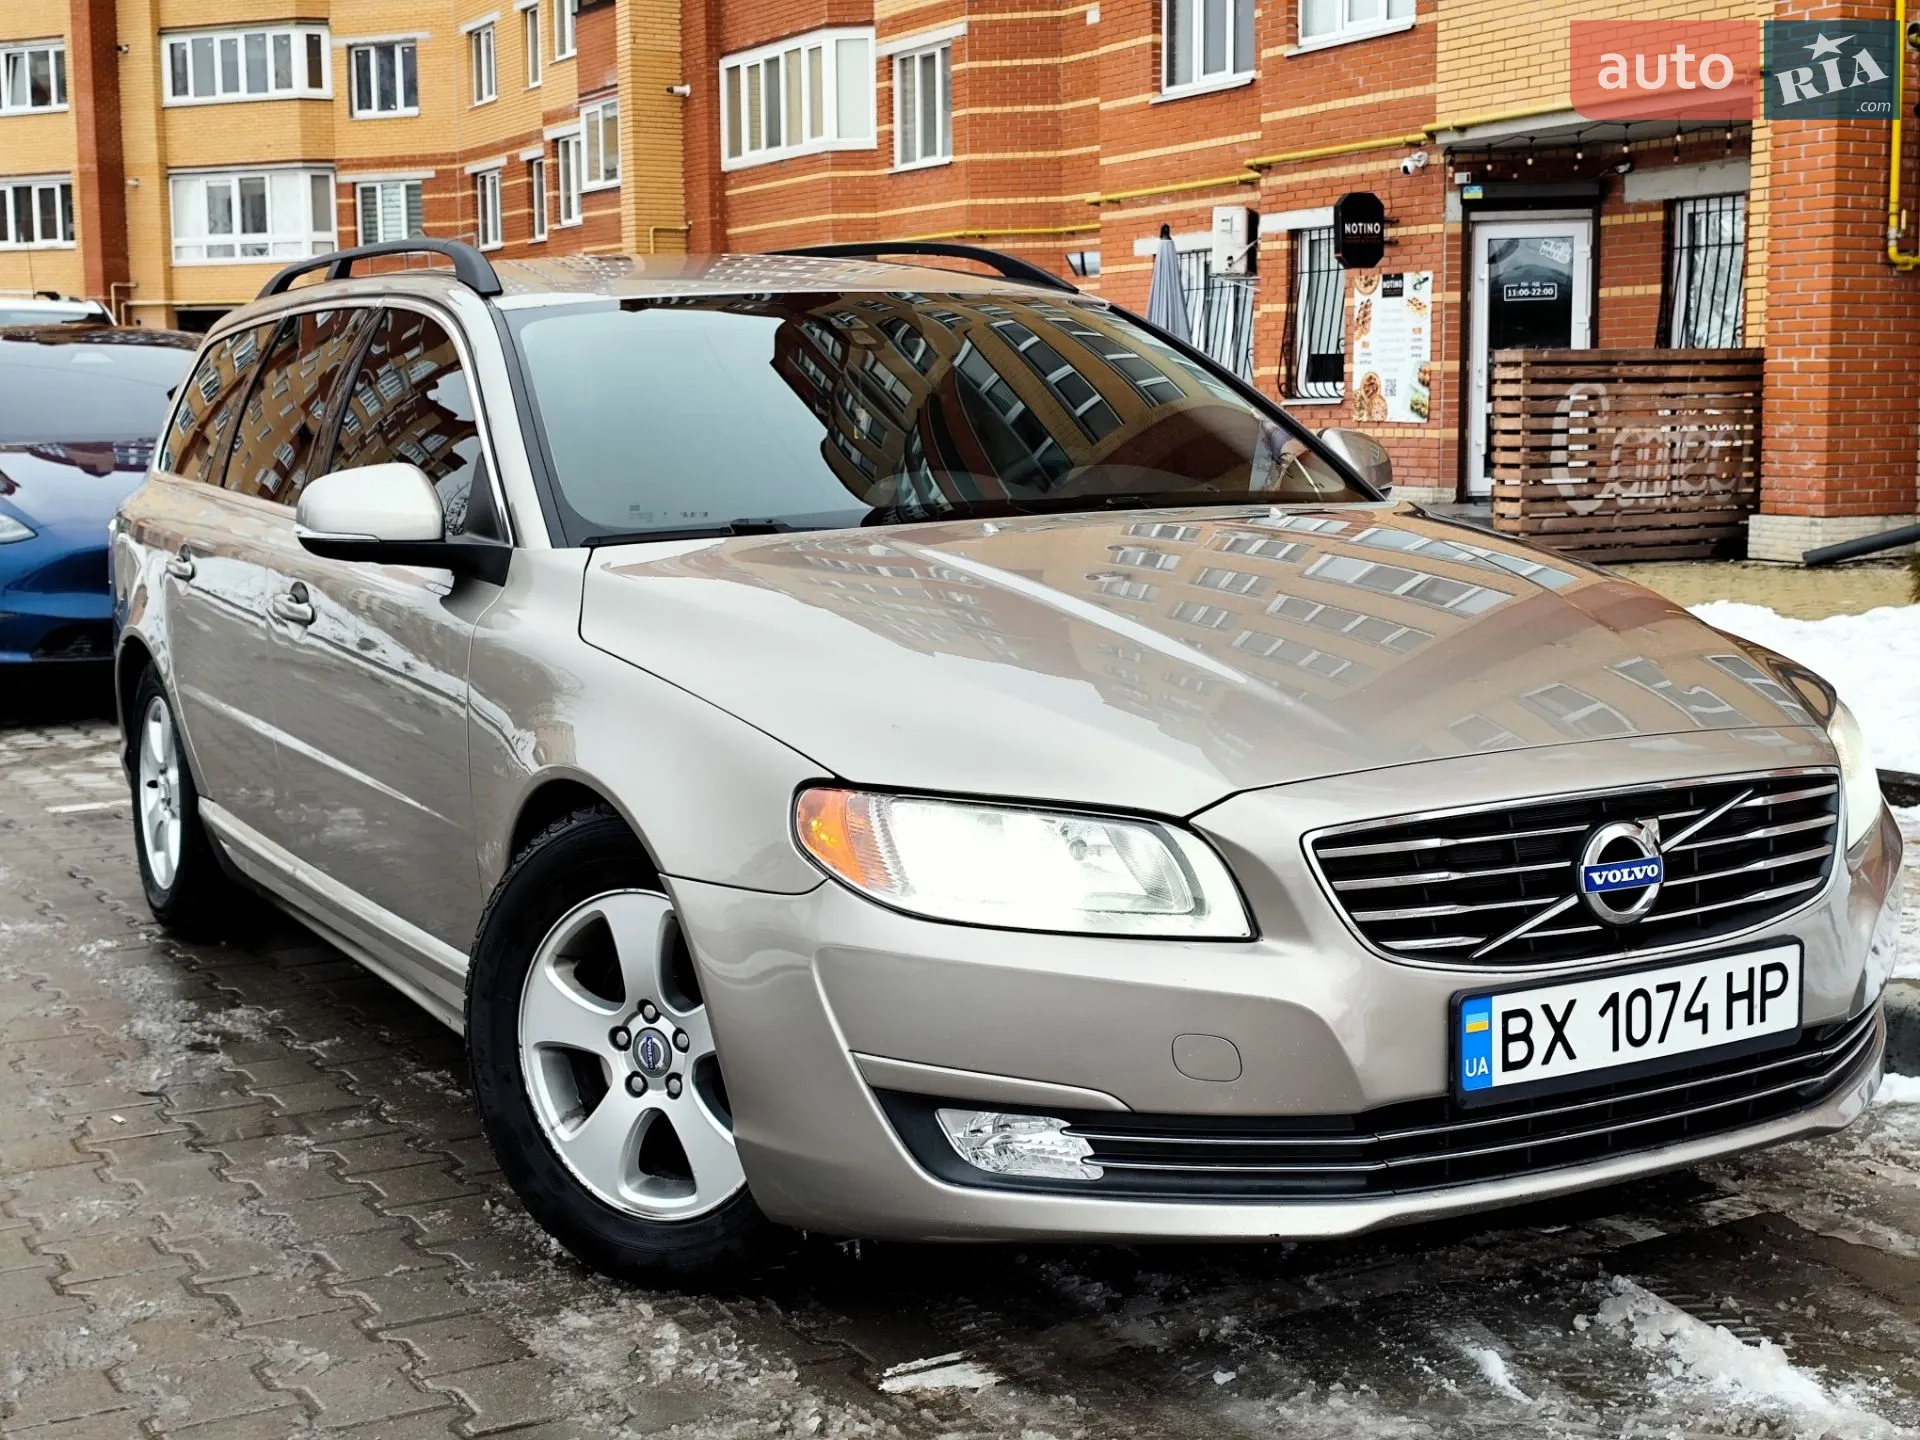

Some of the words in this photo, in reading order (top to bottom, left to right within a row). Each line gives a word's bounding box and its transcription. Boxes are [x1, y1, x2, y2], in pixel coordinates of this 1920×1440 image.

[1344, 222, 1381, 235] NOTINO
[1383, 280, 1403, 289] NOTINO
[1507, 287, 1554, 297] 11:00-22:00
[1588, 864, 1659, 885] VOLVO
[1598, 976, 1709, 1052] 1074
[1465, 1057, 1489, 1078] UA
